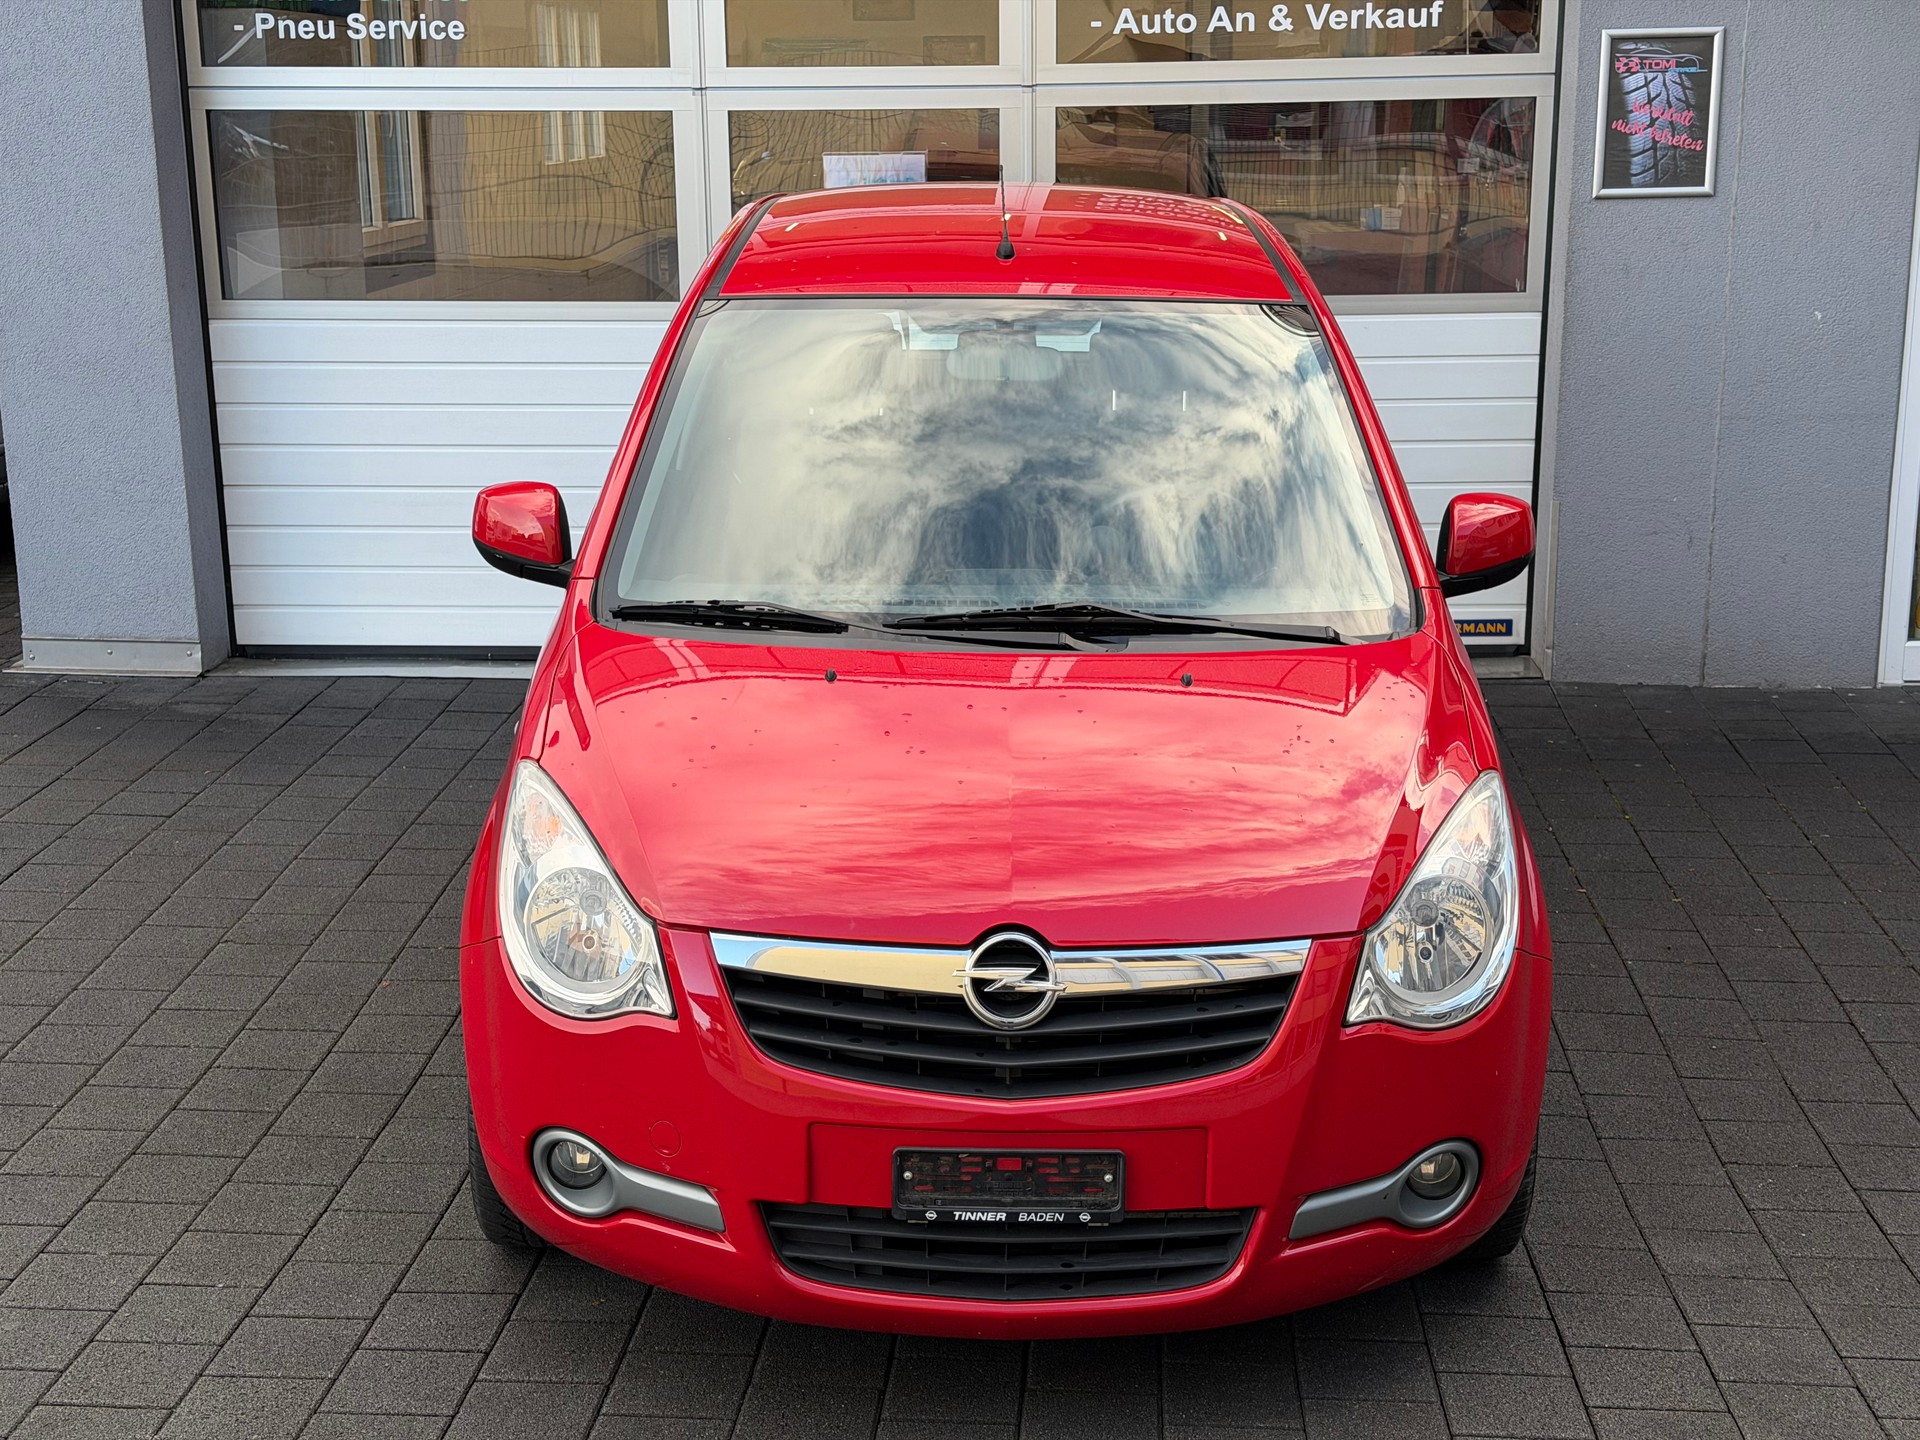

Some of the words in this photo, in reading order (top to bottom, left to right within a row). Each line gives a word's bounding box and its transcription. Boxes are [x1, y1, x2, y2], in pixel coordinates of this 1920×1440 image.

[255, 13, 336, 40] Pneu
[346, 13, 466, 40] Service
[1113, 8, 1198, 35] Auto
[1207, 6, 1256, 33] An
[1268, 4, 1294, 32] &
[1305, 0, 1444, 30] Verkauf
[953, 1212, 1007, 1222] TINNER
[1018, 1212, 1065, 1222] BADEN
